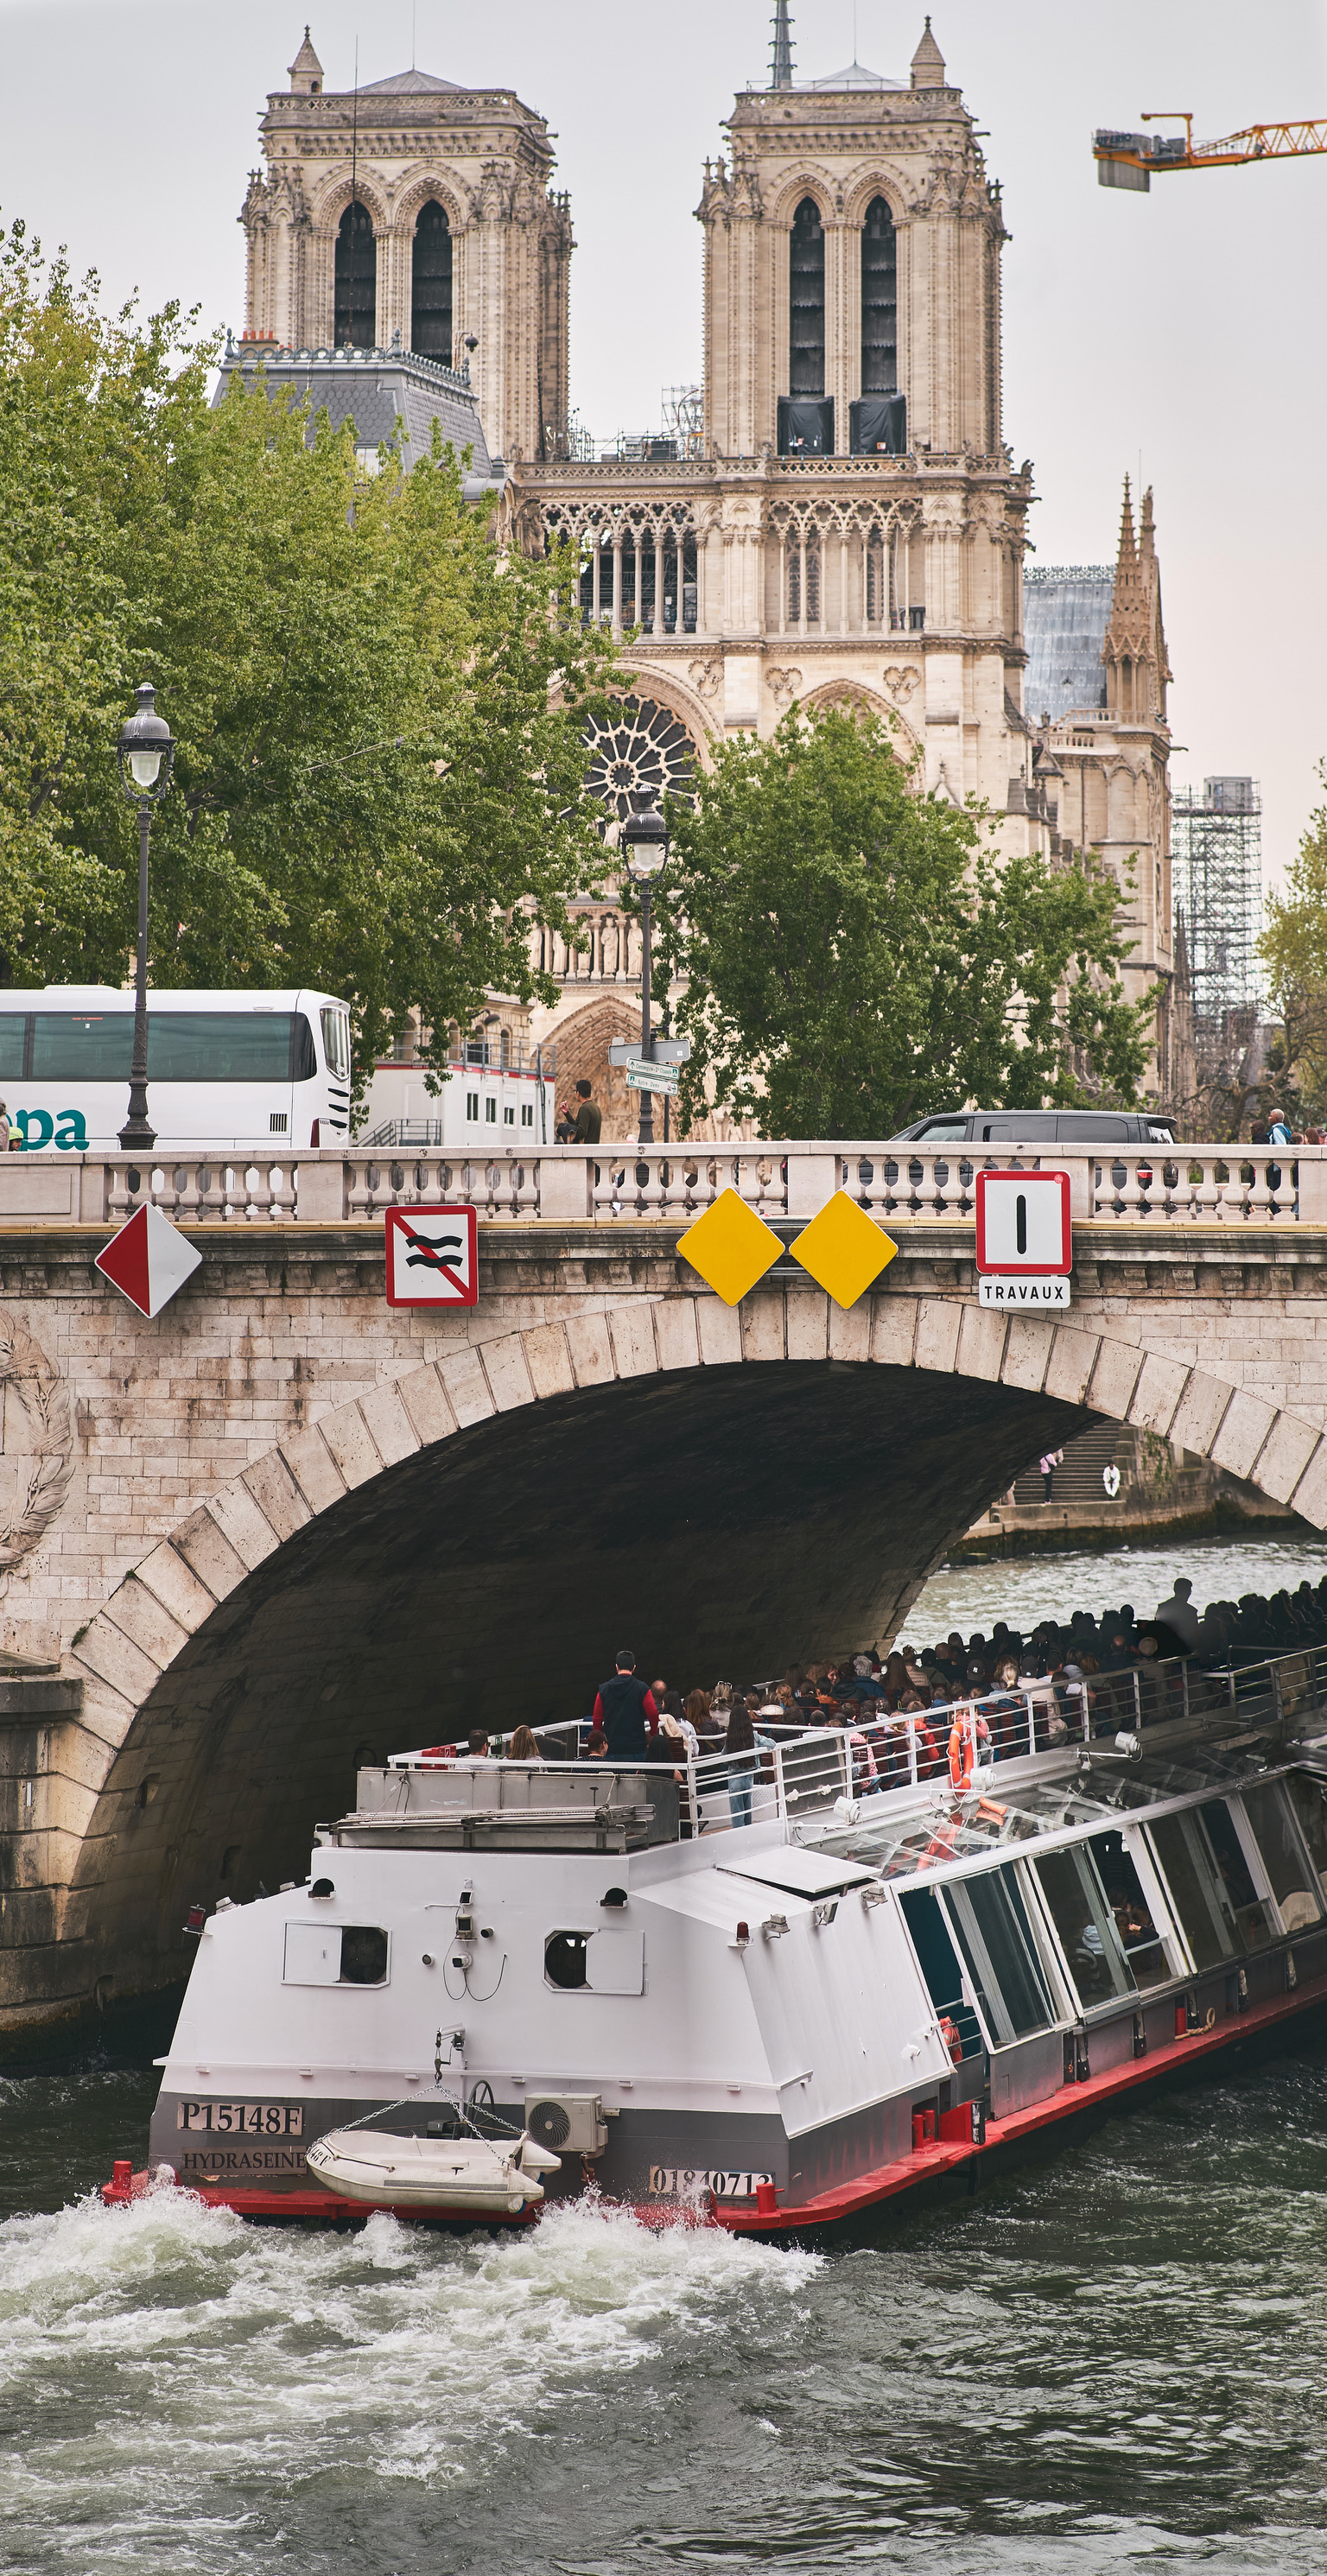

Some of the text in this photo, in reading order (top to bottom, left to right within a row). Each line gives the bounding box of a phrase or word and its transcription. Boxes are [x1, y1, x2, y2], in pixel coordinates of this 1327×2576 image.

[985, 1285, 1064, 1300] TRAVAUX
[180, 2102, 301, 2135] P15148F
[182, 2152, 307, 2169] HYDRASEINE
